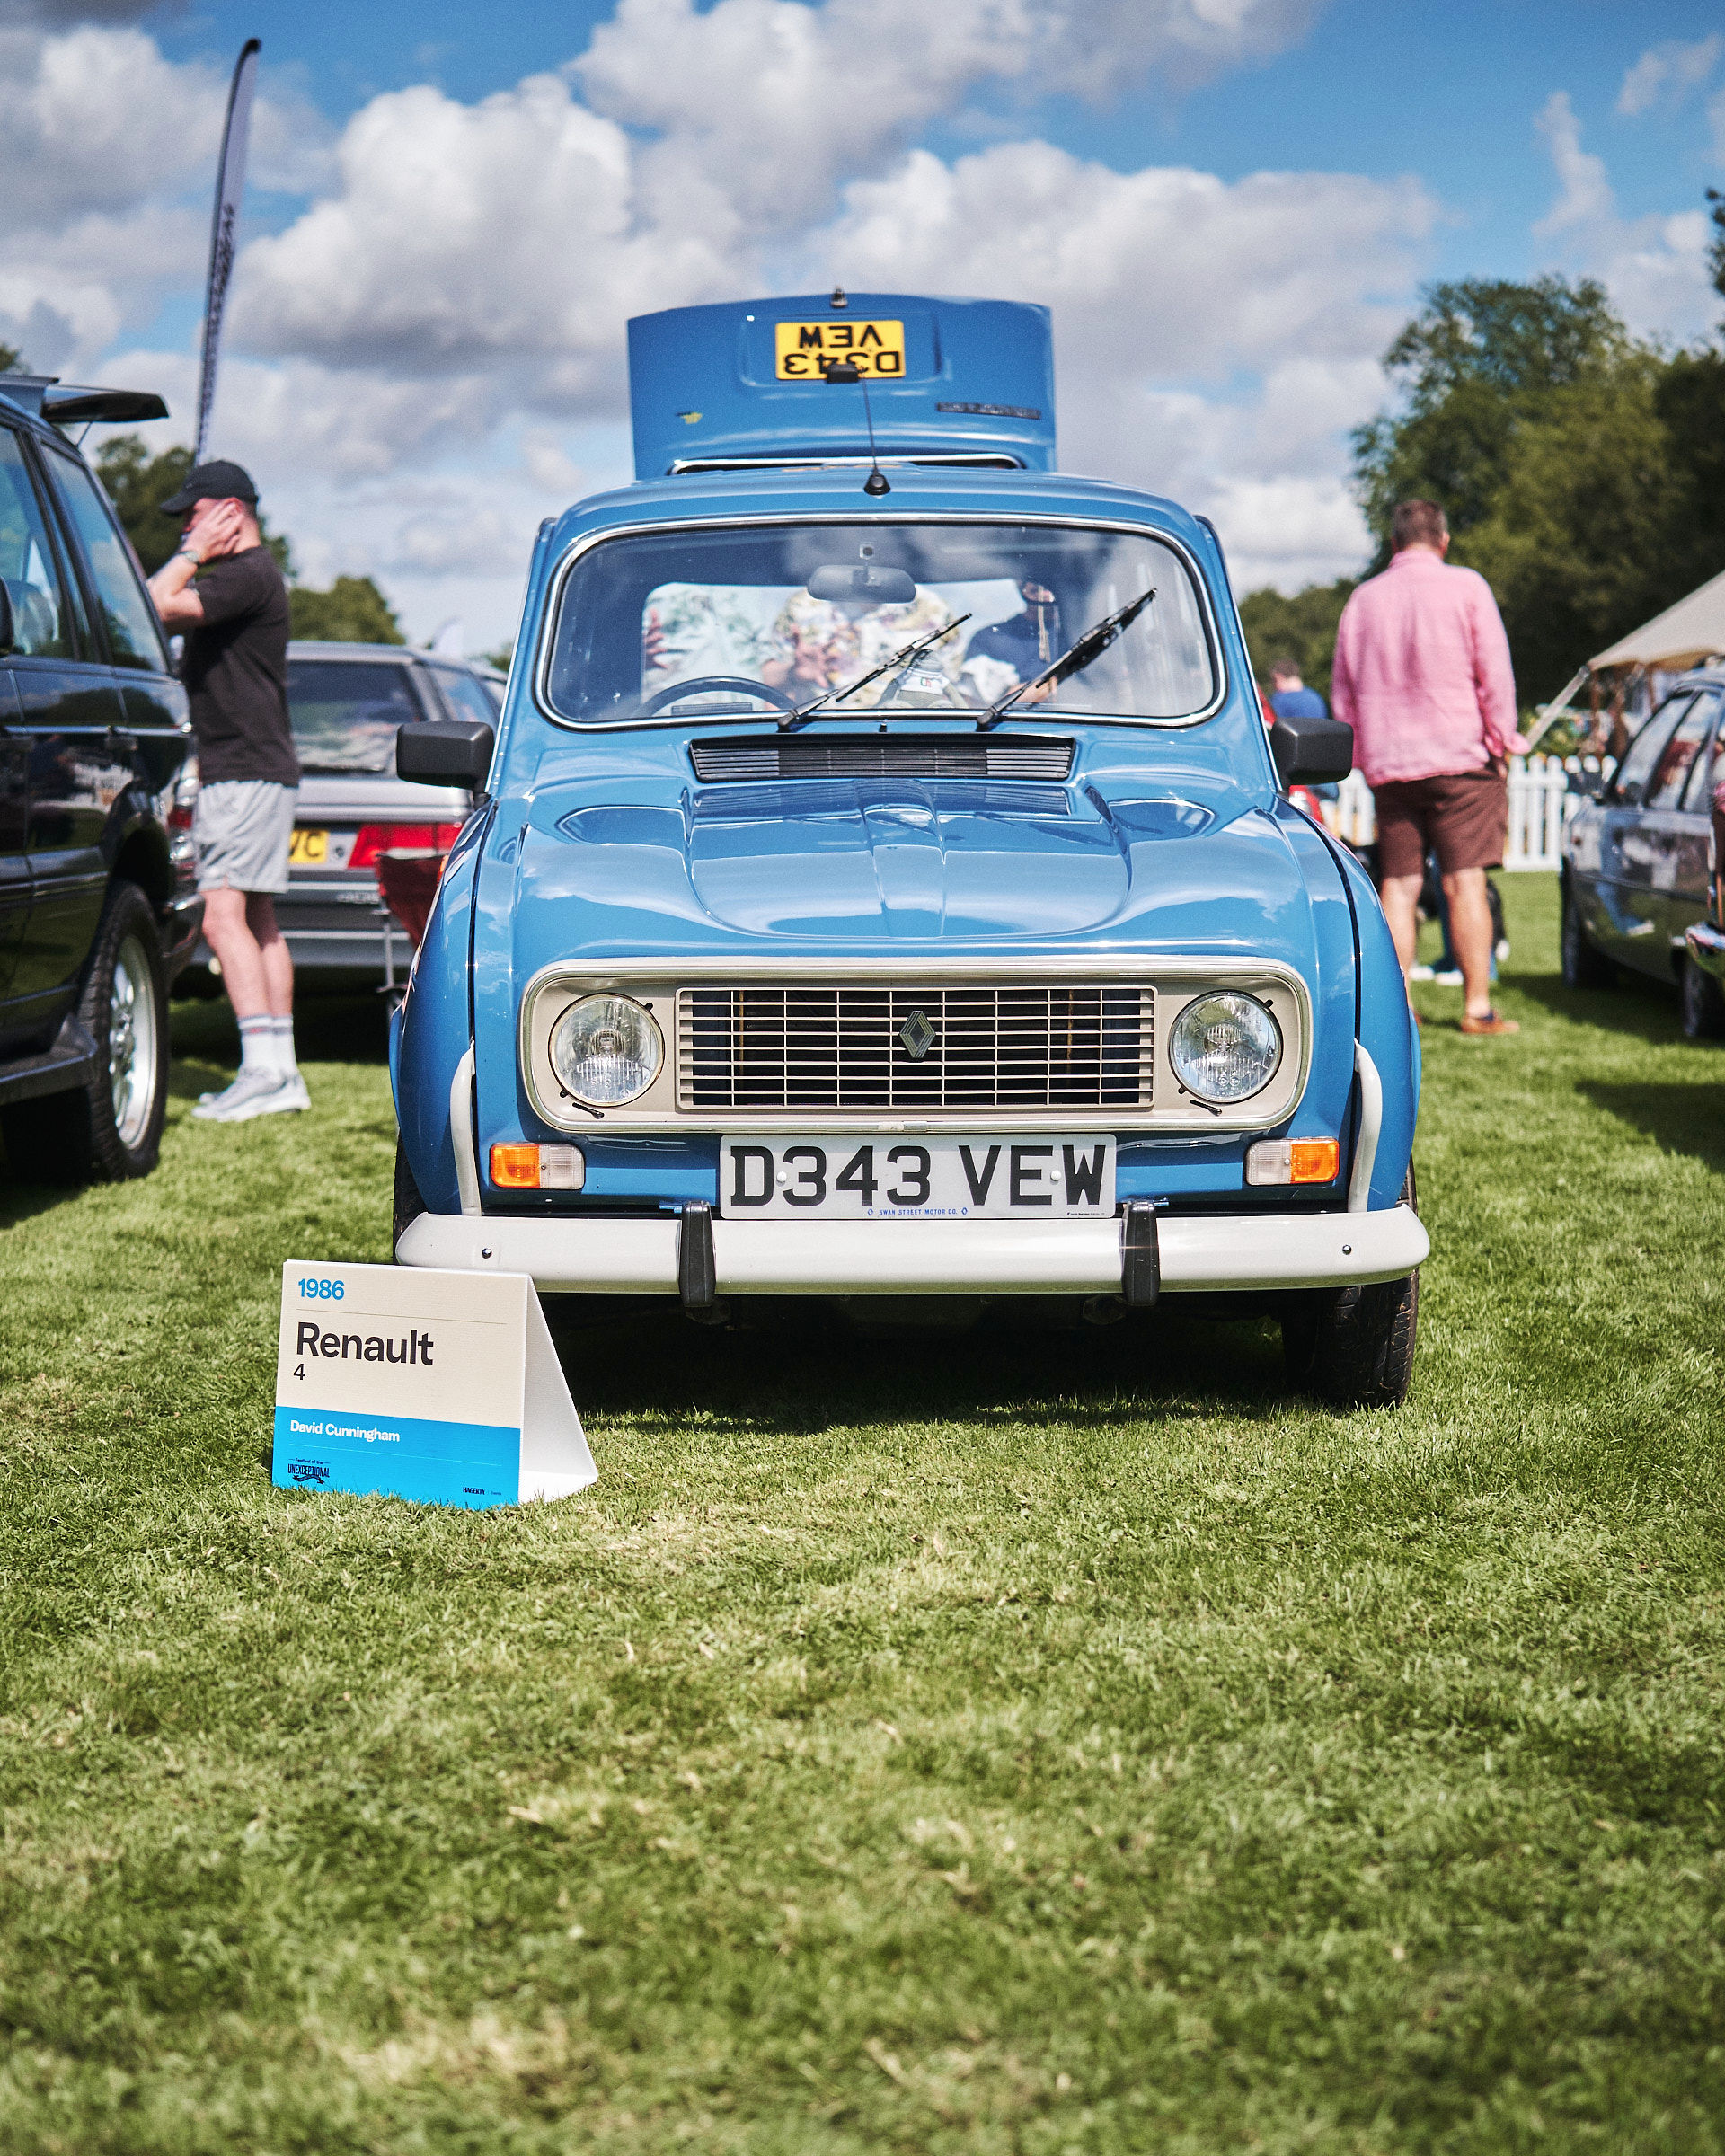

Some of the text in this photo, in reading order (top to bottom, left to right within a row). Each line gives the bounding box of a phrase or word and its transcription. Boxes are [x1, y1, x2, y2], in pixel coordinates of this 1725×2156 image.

[799, 324, 883, 349] VEW
[784, 350, 900, 375] D343
[730, 1144, 1107, 1206] D343 VEW
[297, 1278, 345, 1301] 1986
[296, 1321, 434, 1366] Renault
[293, 1363, 306, 1381] 4
[290, 1419, 401, 1443] David Cunningham
[288, 1463, 330, 1478] UNEXCEPTIONAL
[463, 1487, 485, 1495] HAGERTY
